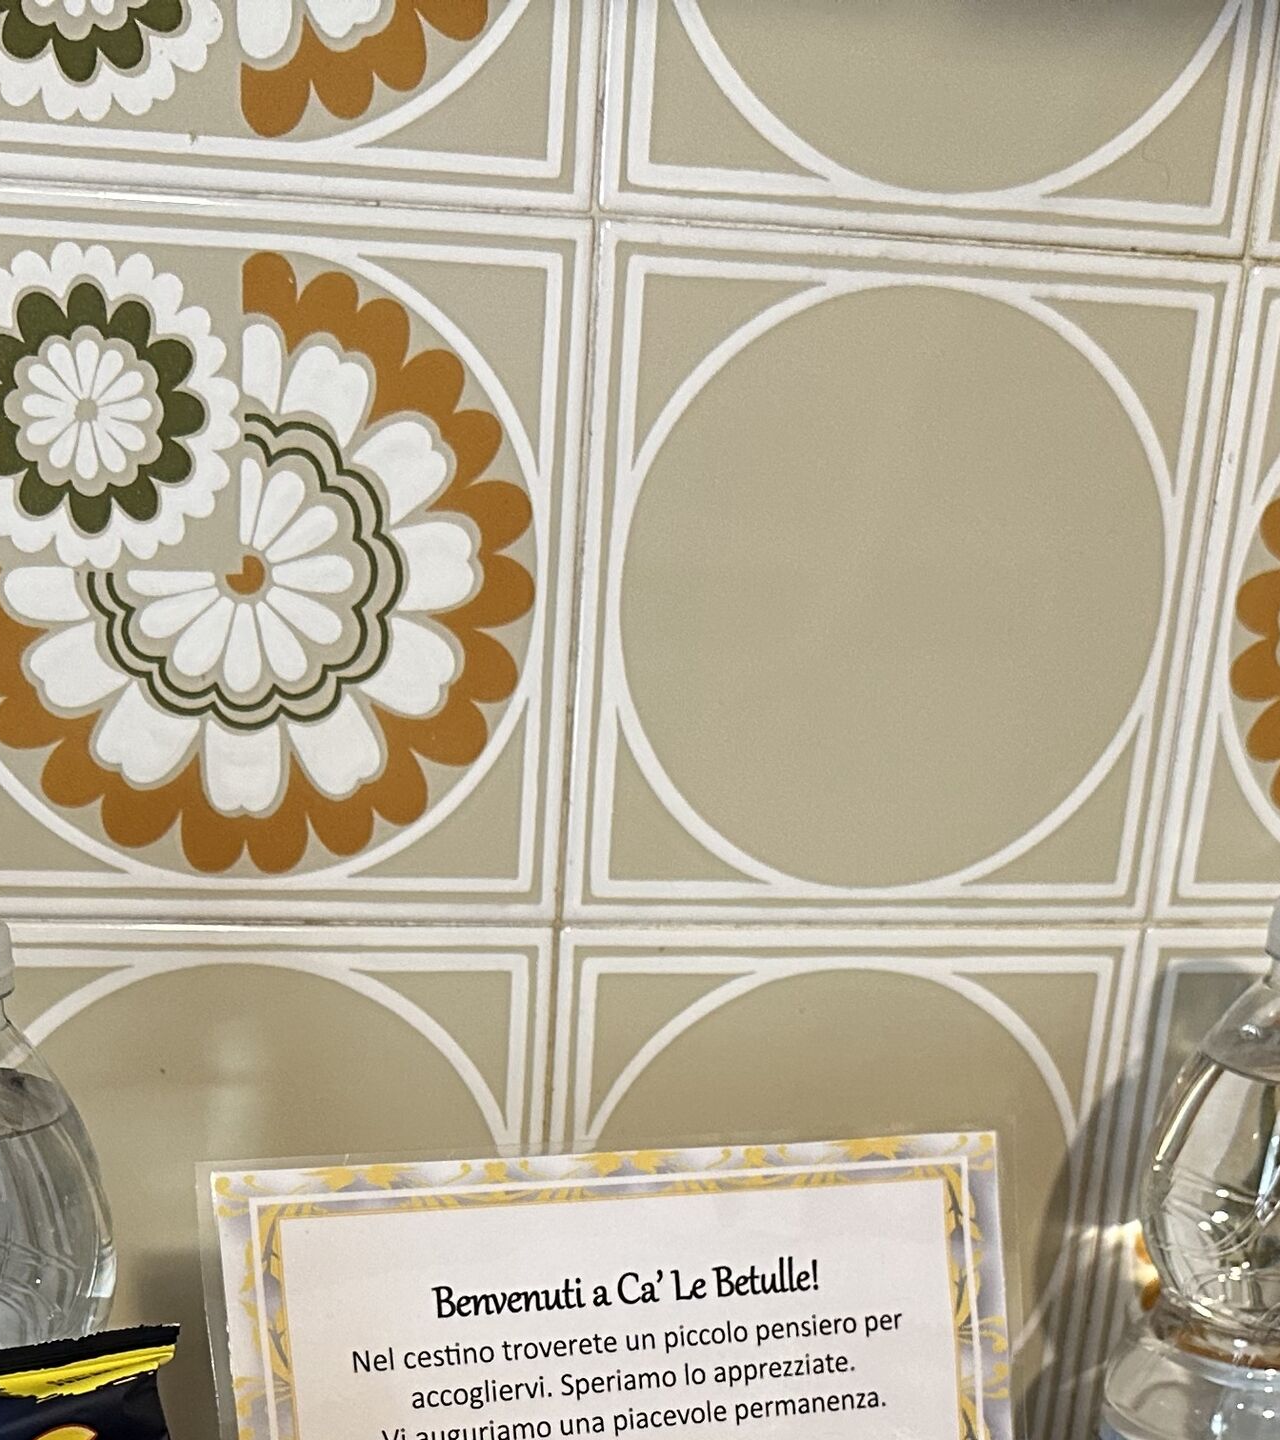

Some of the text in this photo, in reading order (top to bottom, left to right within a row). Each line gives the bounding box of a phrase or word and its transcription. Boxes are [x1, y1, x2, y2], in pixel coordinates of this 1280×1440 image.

[431, 1256, 820, 1318] Benvenuti a Ca' Le Betulle!
[352, 1311, 903, 1373] Nel cestino troverete un piccolo pensiero per
[412, 1353, 856, 1410] accogliervi. Speriamo lo apprezziate.
[560, 1415, 605, 1436] una
[614, 1400, 727, 1437] piacevole
[735, 1388, 887, 1426] permanenza.
